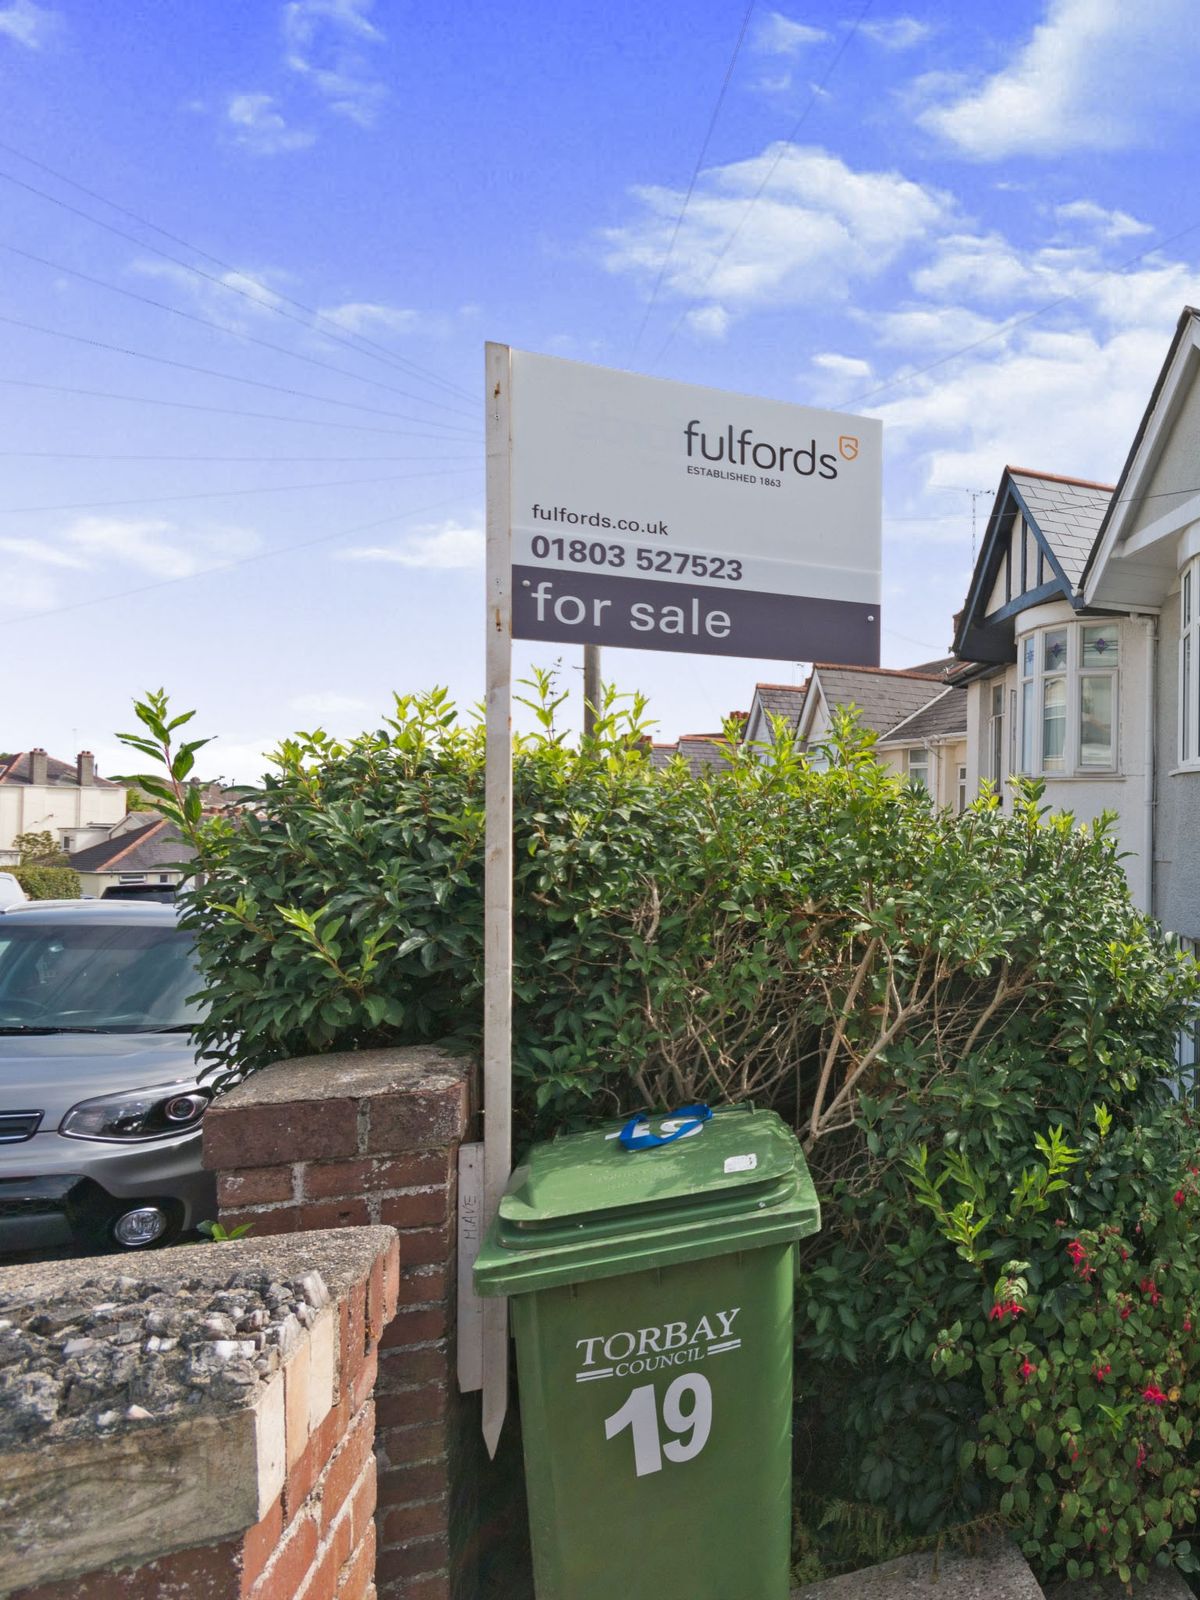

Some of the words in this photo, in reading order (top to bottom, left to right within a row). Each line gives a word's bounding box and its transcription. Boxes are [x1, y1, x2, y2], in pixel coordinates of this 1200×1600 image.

[684, 420, 838, 480] fulfords
[687, 465, 757, 484] ESTABLISHED
[759, 476, 782, 488] 1863
[531, 504, 669, 536] fulfords.co.uk
[531, 535, 626, 568] 01803
[636, 548, 743, 581] 527523
[531, 581, 612, 627] for
[629, 597, 732, 639] sale
[575, 1307, 741, 1366] TORBAY
[615, 1347, 705, 1377] COUNCIL
[604, 1372, 713, 1477] 19
